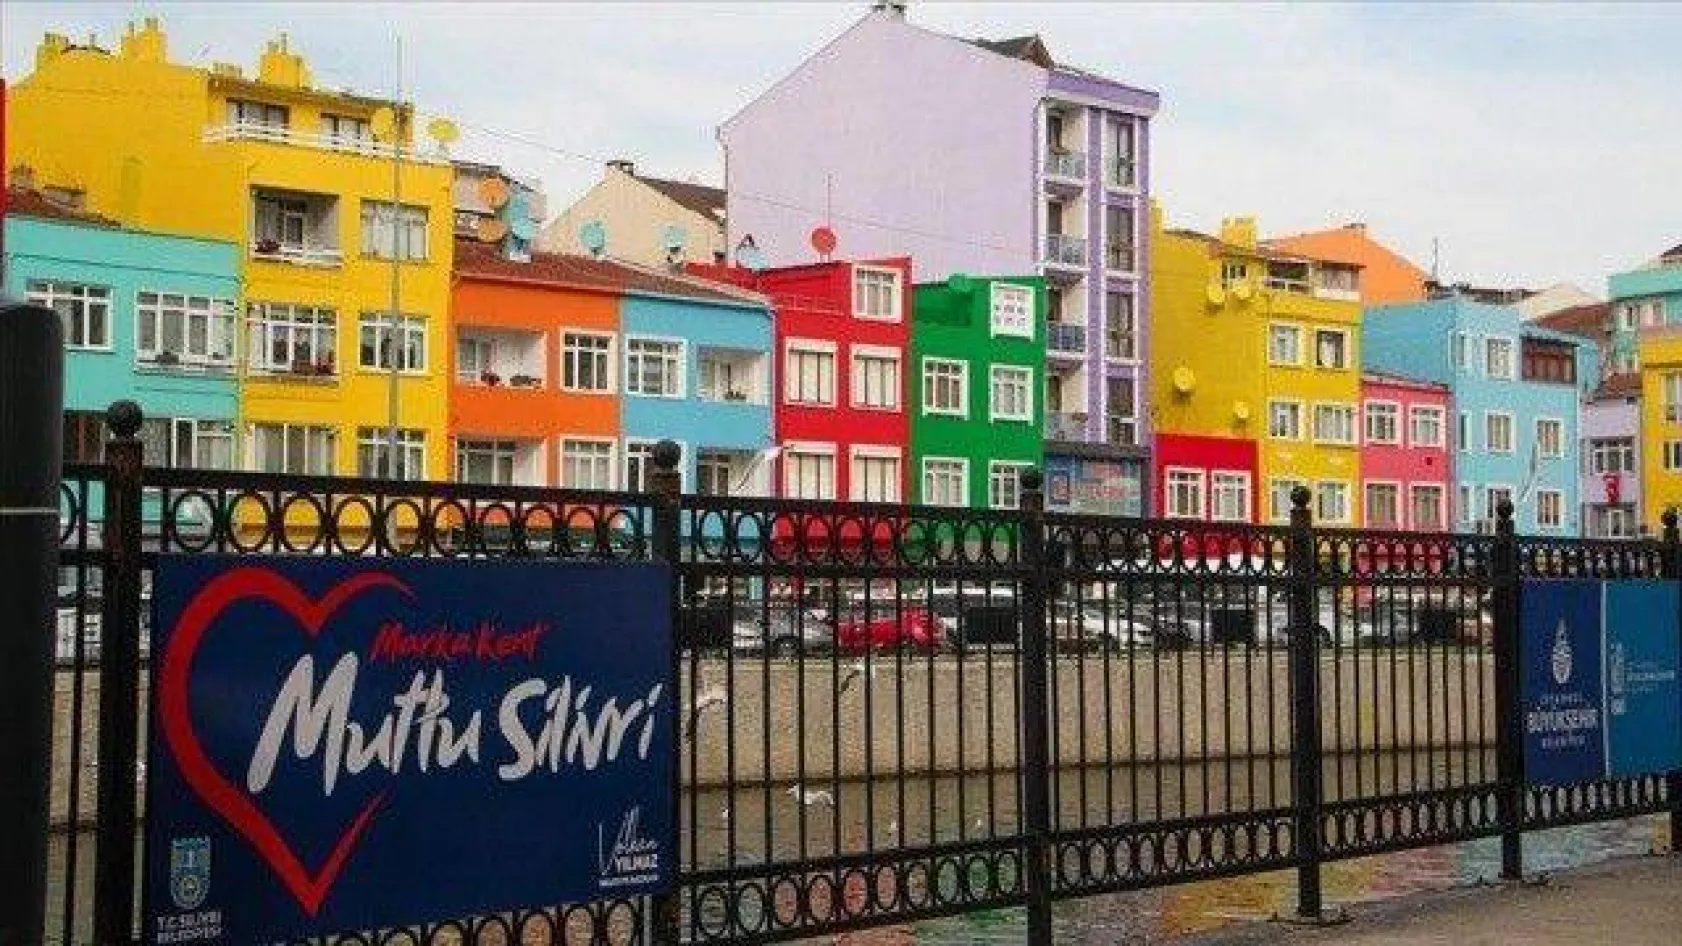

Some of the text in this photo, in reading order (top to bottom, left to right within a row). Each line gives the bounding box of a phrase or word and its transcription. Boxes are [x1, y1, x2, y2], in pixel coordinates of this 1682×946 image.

[369, 620, 549, 661] Marka Kent
[246, 651, 663, 797] Mutlu Silivri
